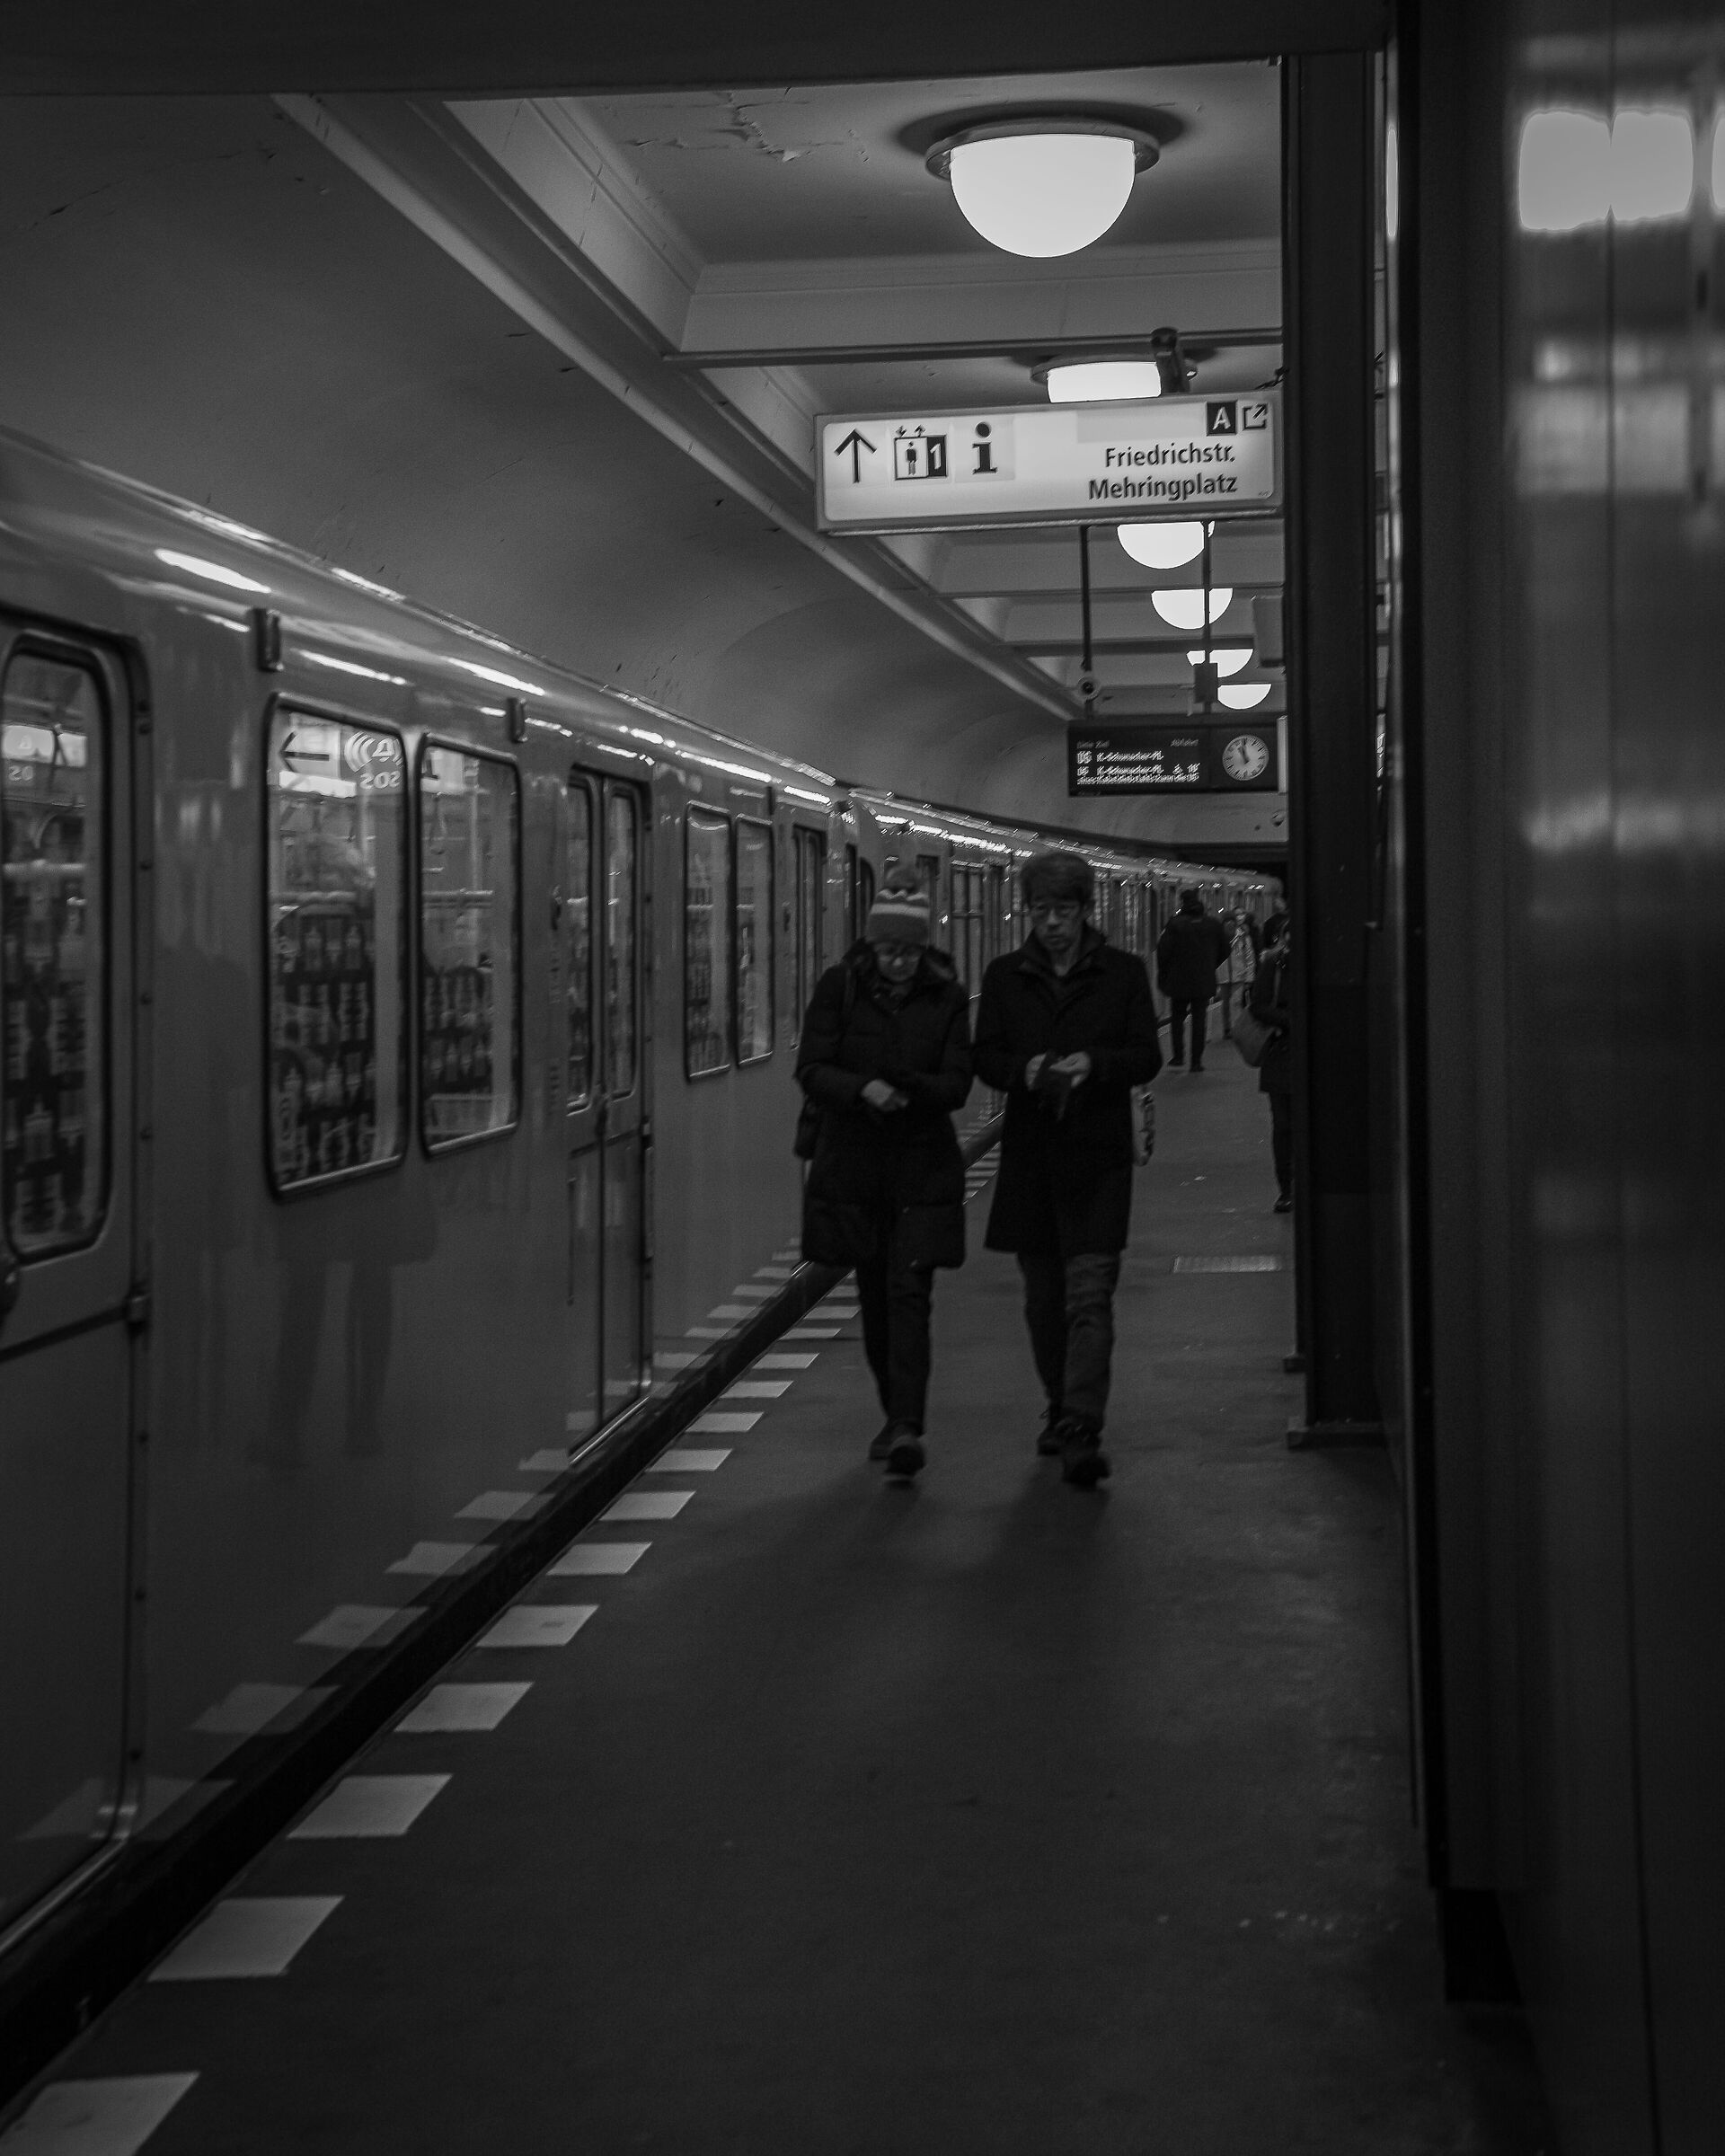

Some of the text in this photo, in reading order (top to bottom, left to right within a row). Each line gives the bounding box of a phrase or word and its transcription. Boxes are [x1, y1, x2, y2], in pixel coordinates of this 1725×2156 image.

[1212, 406, 1231, 430] A
[929, 443, 942, 470] 1
[1104, 442, 1236, 468] Friedrichstr.
[1088, 473, 1238, 501] Mehringplatz
